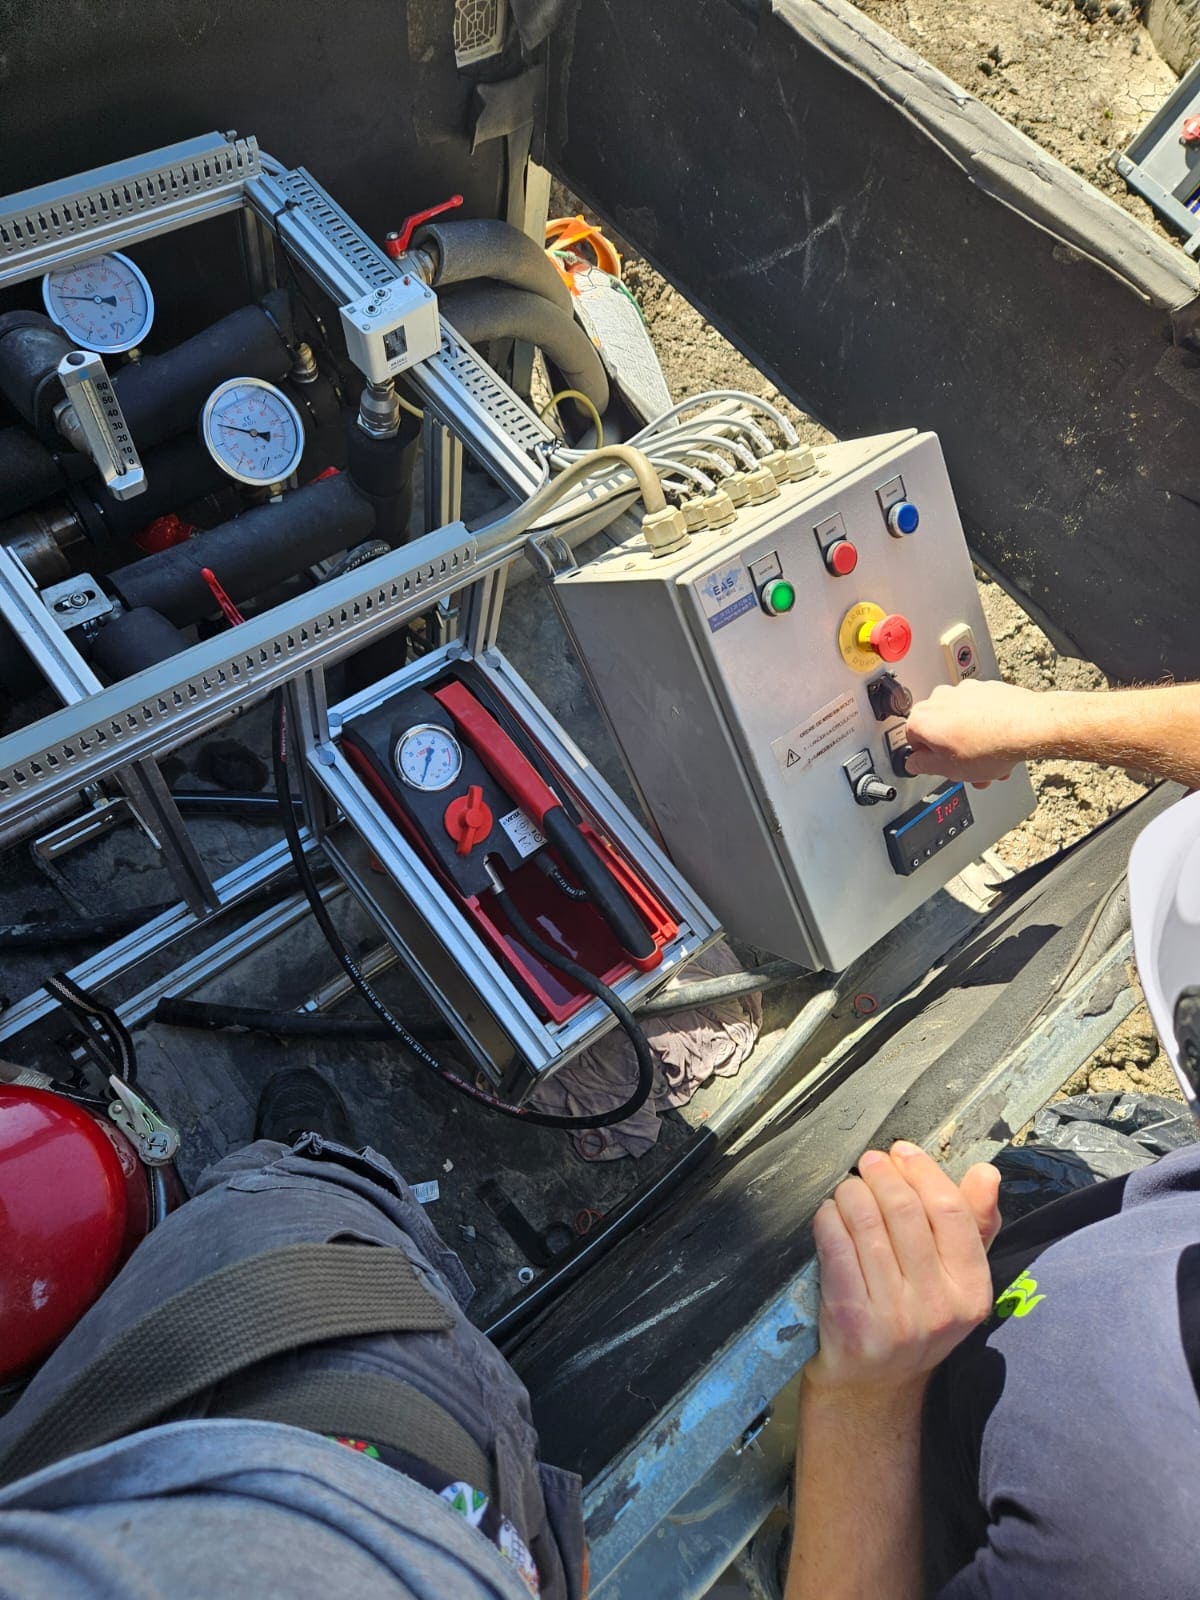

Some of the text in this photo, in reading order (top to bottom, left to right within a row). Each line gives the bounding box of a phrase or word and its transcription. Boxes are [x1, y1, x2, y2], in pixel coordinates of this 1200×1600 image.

[97, 382, 108, 391] 60
[102, 396, 113, 404] 50
[108, 409, 118, 417] 40
[112, 422, 123, 430] 30
[117, 434, 128, 443] 20
[123, 446, 132, 454] 10
[712, 577, 735, 596] EAS
